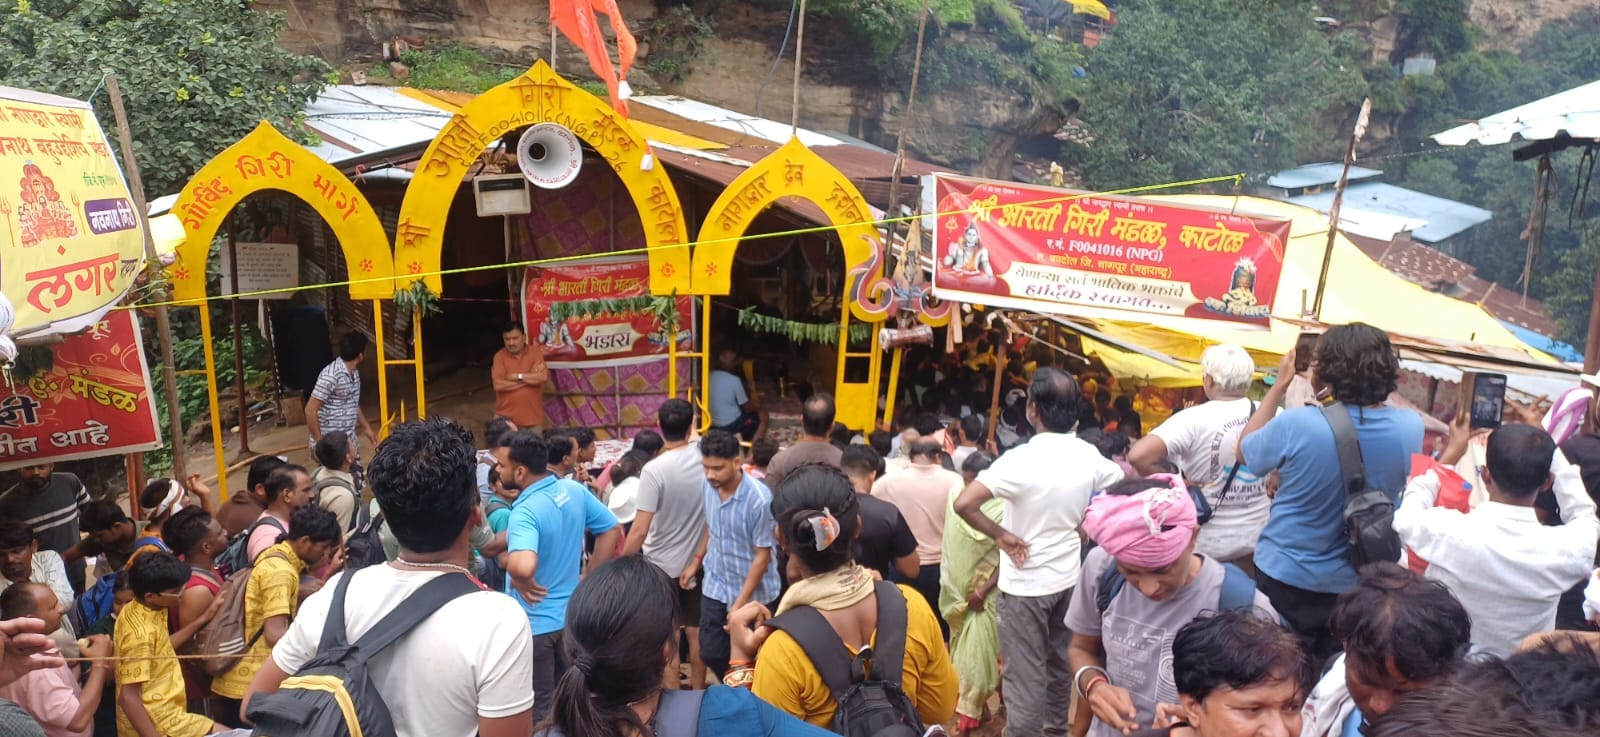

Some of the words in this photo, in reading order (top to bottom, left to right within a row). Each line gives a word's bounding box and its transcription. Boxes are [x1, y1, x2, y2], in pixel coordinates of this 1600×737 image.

[0, 136, 34, 156] नाथ
[313, 174, 359, 221] मार्ग
[968, 194, 998, 222] श्री
[1063, 204, 1109, 237] गिरी
[1069, 239, 1123, 257] F0041016
[1126, 246, 1163, 262] (NPG)
[25, 245, 120, 314] लंगर
[86, 319, 112, 340] पूर
[585, 329, 632, 352] भंडारा
[68, 368, 138, 413] मंडळ
[0, 394, 41, 428] री
[0, 432, 38, 458] ीत
[50, 419, 111, 448] आहे
